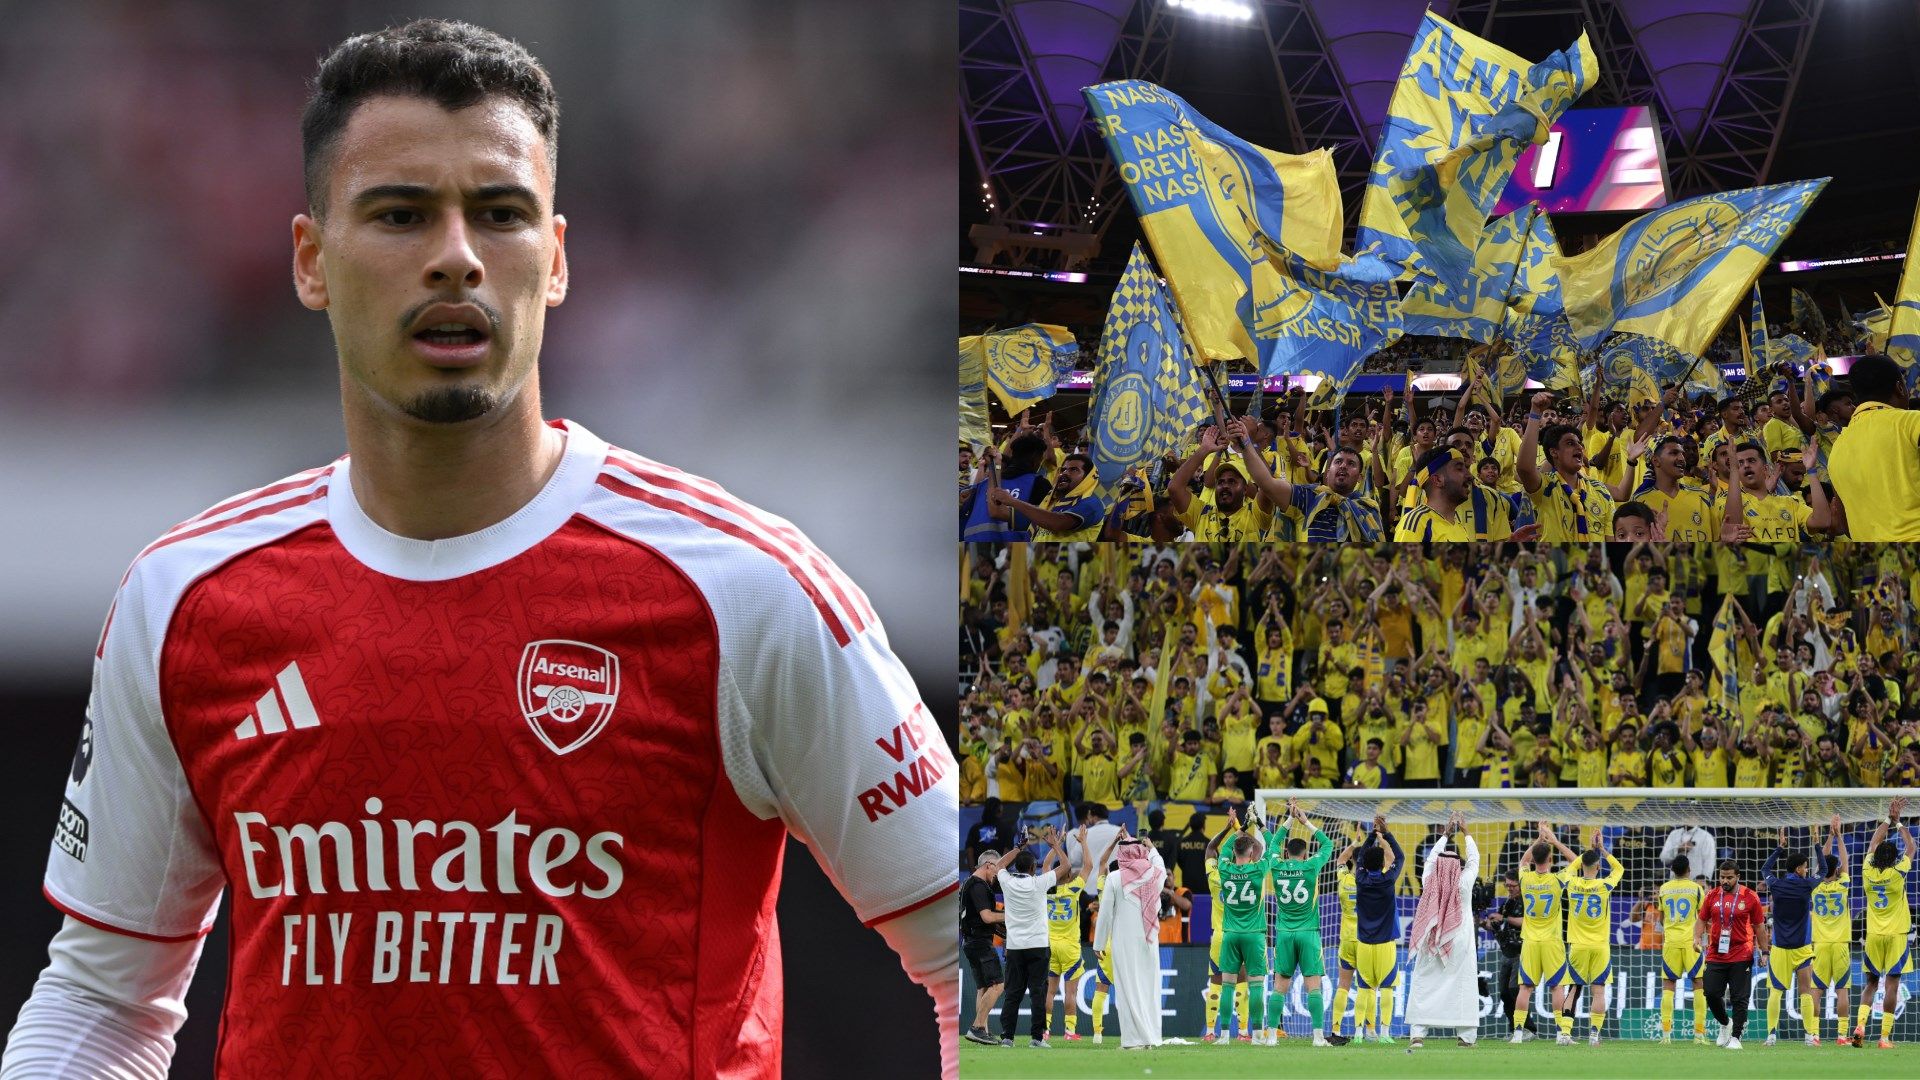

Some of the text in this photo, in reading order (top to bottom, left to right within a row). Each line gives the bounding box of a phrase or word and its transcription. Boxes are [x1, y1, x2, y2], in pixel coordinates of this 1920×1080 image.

[1071, 376, 1094, 384] CHAM
[1672, 529, 1707, 542] AFD
[533, 657, 606, 684] Arsenal
[234, 797, 624, 899] Emirates
[1181, 841, 1205, 850] POLICE
[1223, 881, 1257, 905] 24
[1277, 879, 1309, 904] 36
[1872, 884, 1889, 909] 3
[1047, 898, 1073, 921] 23
[1524, 893, 1554, 918] 27
[1570, 892, 1602, 918] 78
[1665, 897, 1691, 923] 19
[1814, 893, 1844, 917] 83
[282, 911, 564, 986] FLY BETTER
